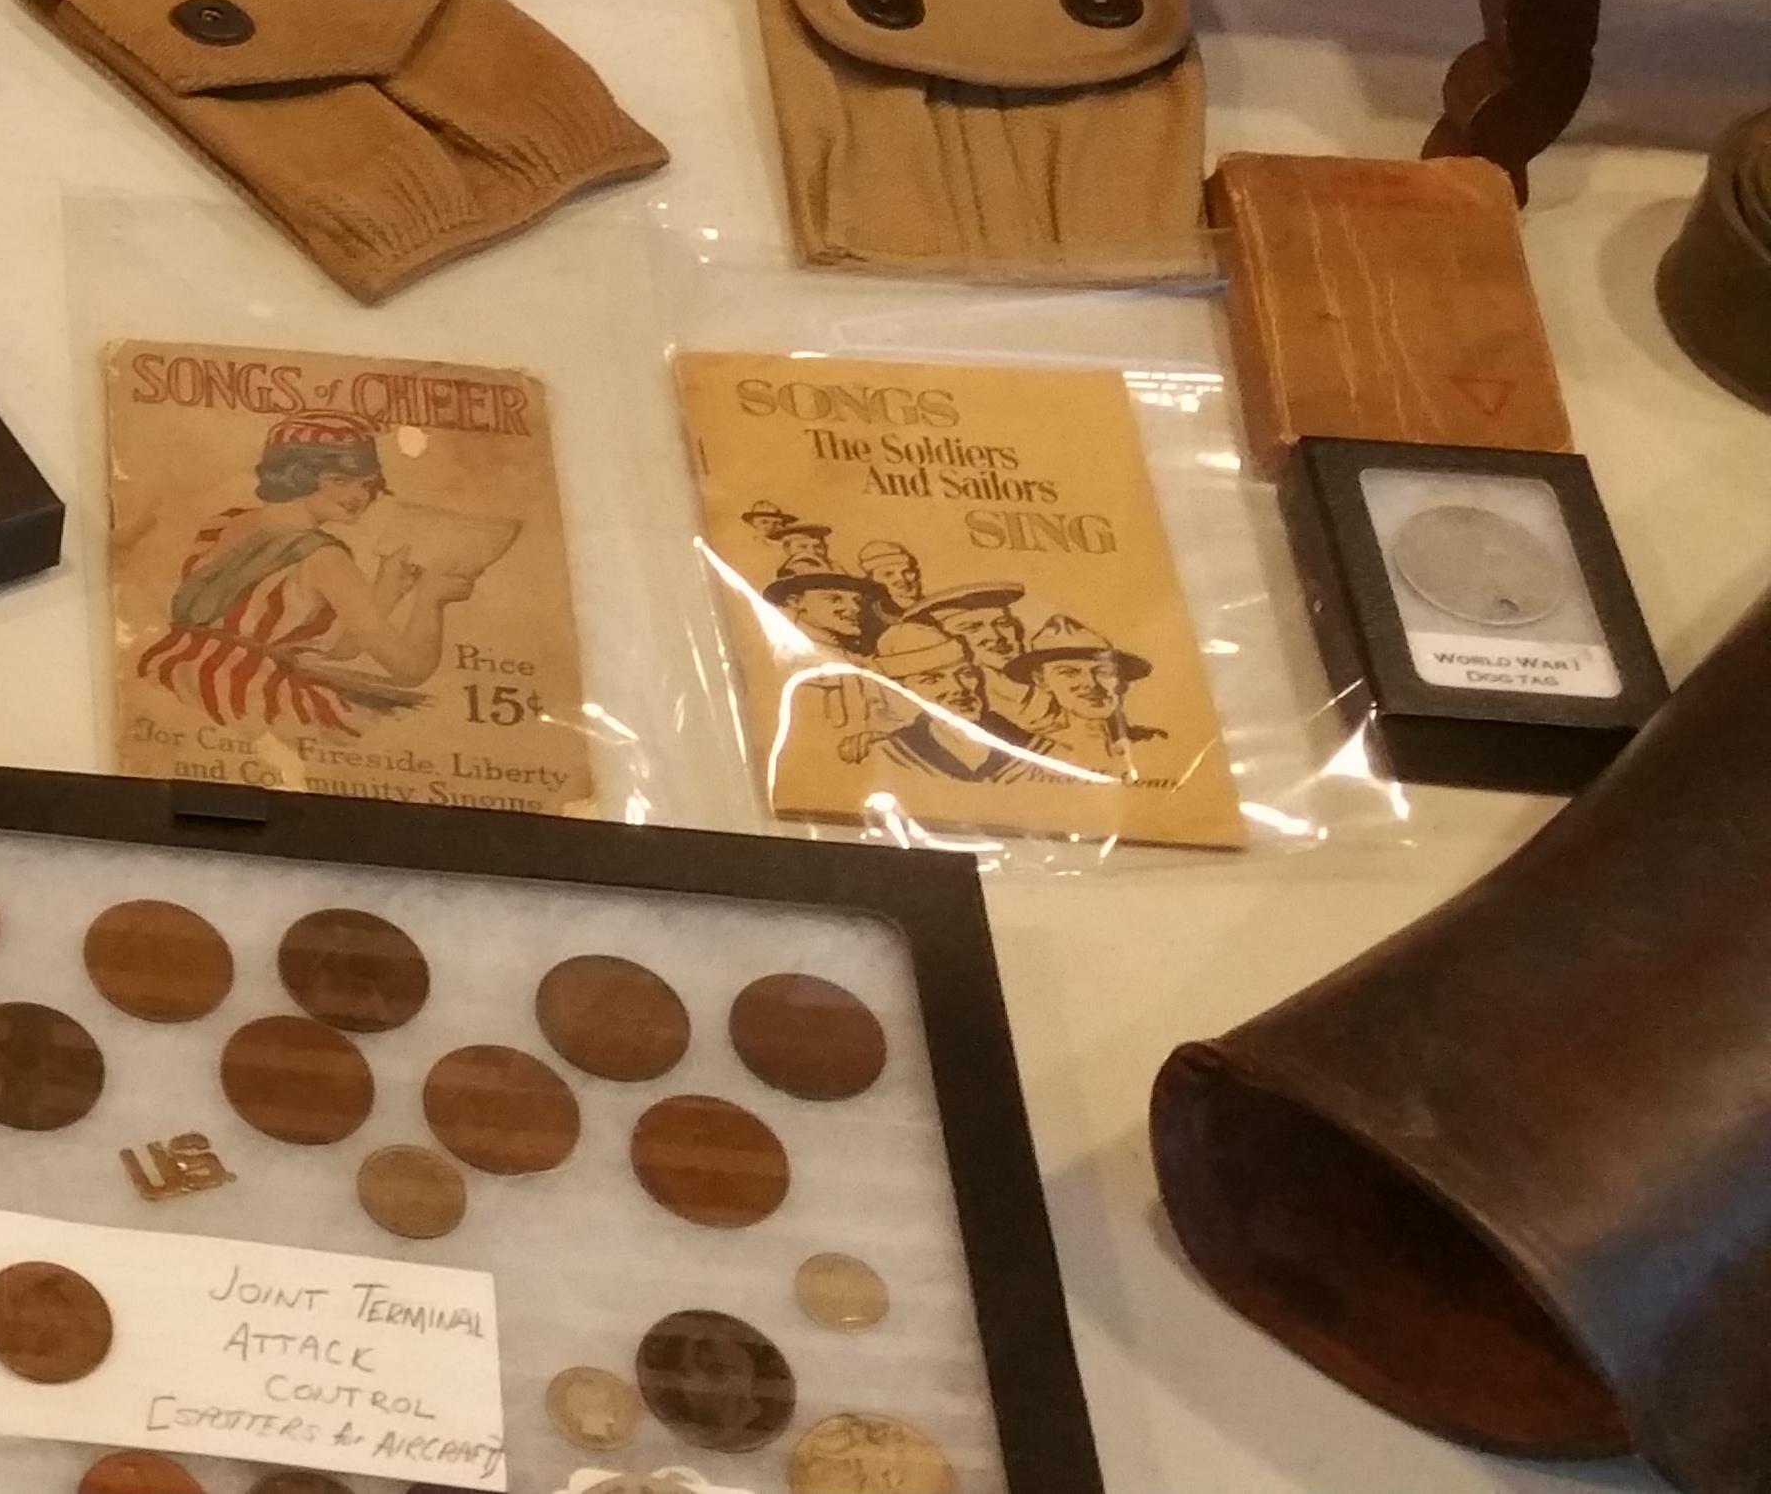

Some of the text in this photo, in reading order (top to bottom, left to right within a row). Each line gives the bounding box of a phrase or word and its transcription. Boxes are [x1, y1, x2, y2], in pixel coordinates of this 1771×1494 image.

[132, 354, 531, 436] SONGS of CHEER
[735, 378, 961, 428] SONGS
[804, 428, 1020, 470] The Soldiers
[864, 465, 1059, 504] And Sailors
[964, 509, 1118, 555] SING
[455, 642, 536, 677] Price
[1433, 652, 1511, 667] WORLD
[1516, 656, 1568, 670] WAR
[462, 685, 545, 727] 15¢
[133, 718, 186, 747] For
[451, 752, 570, 793] Liberty
[174, 759, 226, 780] and
[209, 1265, 486, 1339] JOINT TERMINAL
[222, 1322, 376, 1373] ATTACK
[265, 1374, 436, 1420] CONTROL
